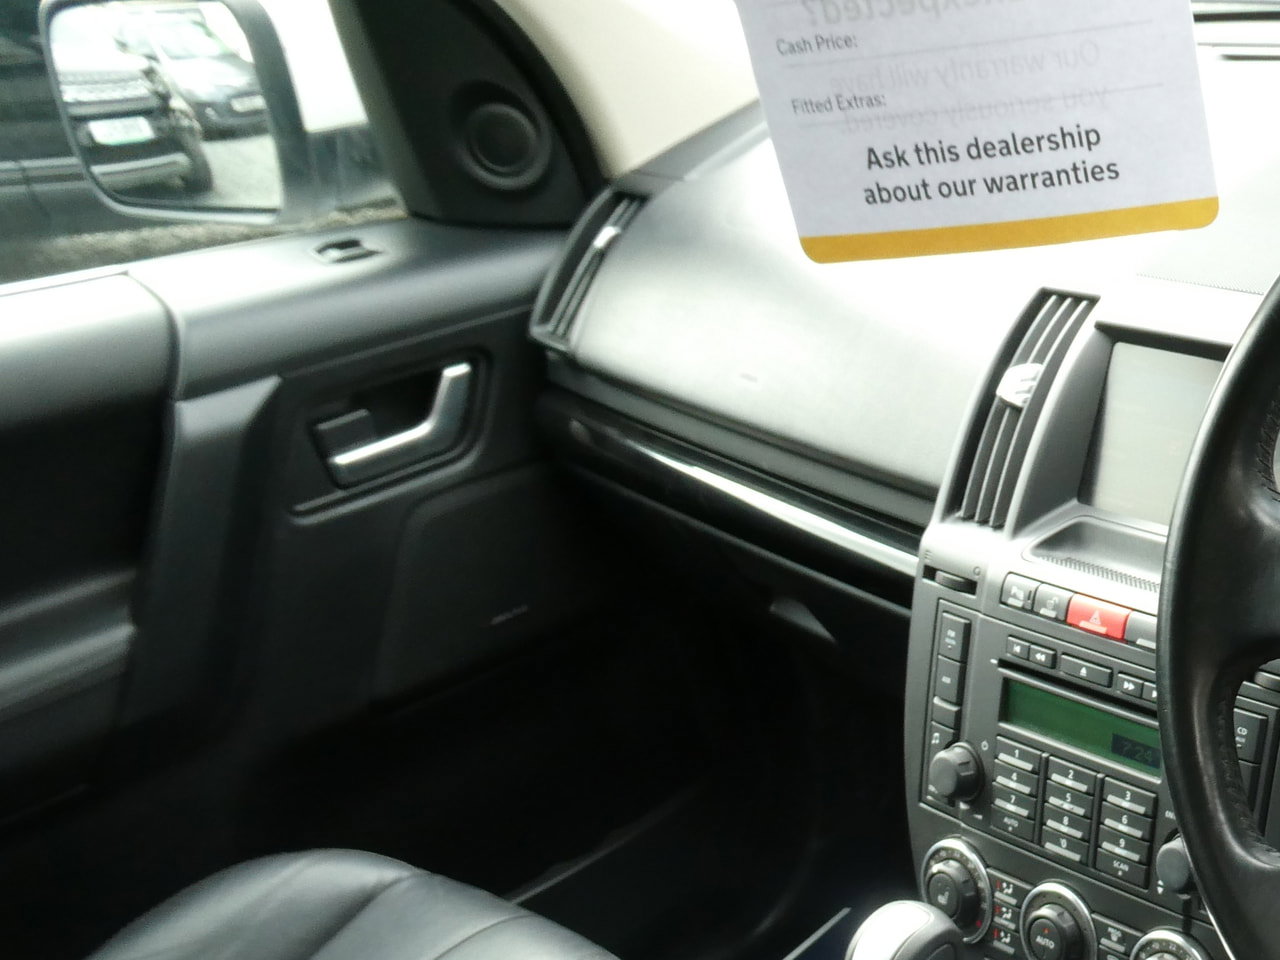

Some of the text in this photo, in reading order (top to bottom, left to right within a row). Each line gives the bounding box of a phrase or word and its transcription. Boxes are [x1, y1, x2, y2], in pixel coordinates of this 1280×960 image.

[776, 33, 858, 56] Cash Price:
[791, 93, 887, 114] Fitted Extras:
[866, 124, 1101, 171] Ask this dealership
[864, 160, 1120, 205] about our warranties
[1036, 935, 1055, 949] AUTO
